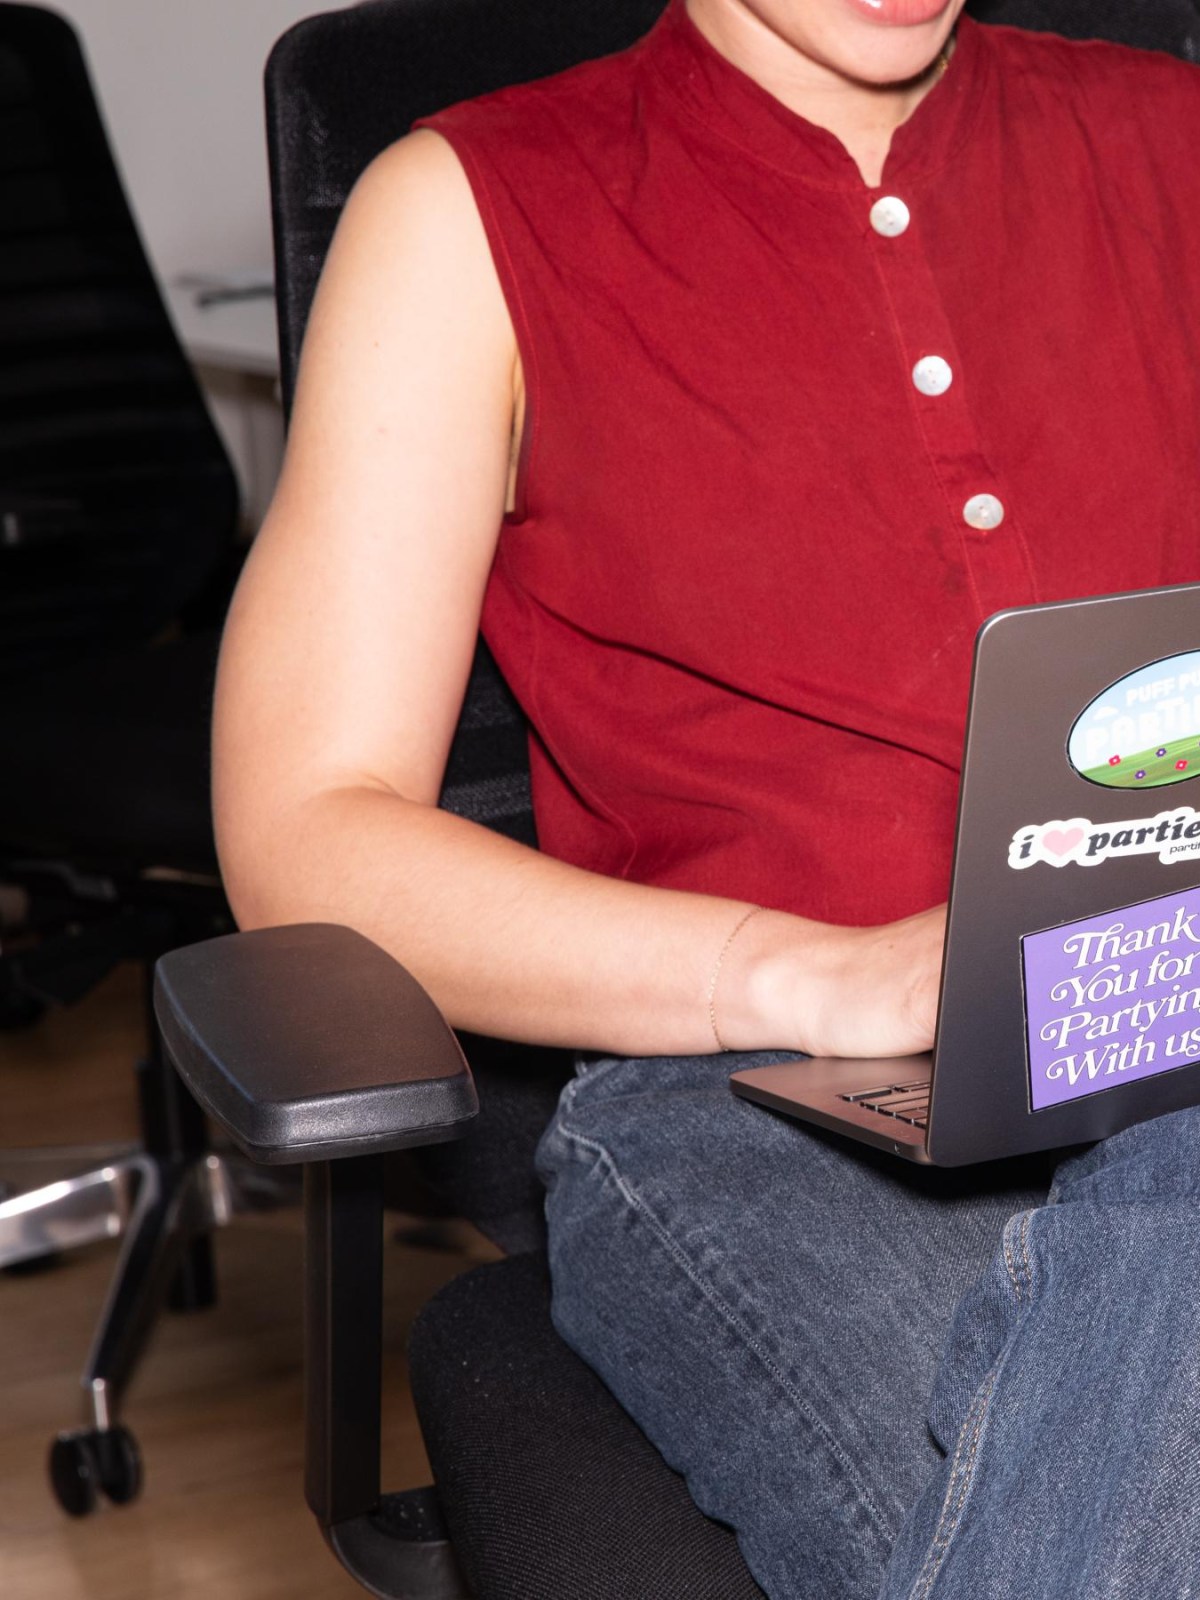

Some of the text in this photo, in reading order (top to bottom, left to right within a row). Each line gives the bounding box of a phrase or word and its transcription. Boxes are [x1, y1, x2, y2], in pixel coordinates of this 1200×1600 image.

[1125, 677, 1176, 706] PUFF
[1019, 834, 1035, 860] i
[1050, 964, 1139, 1009] You
[1045, 1030, 1155, 1086] With
